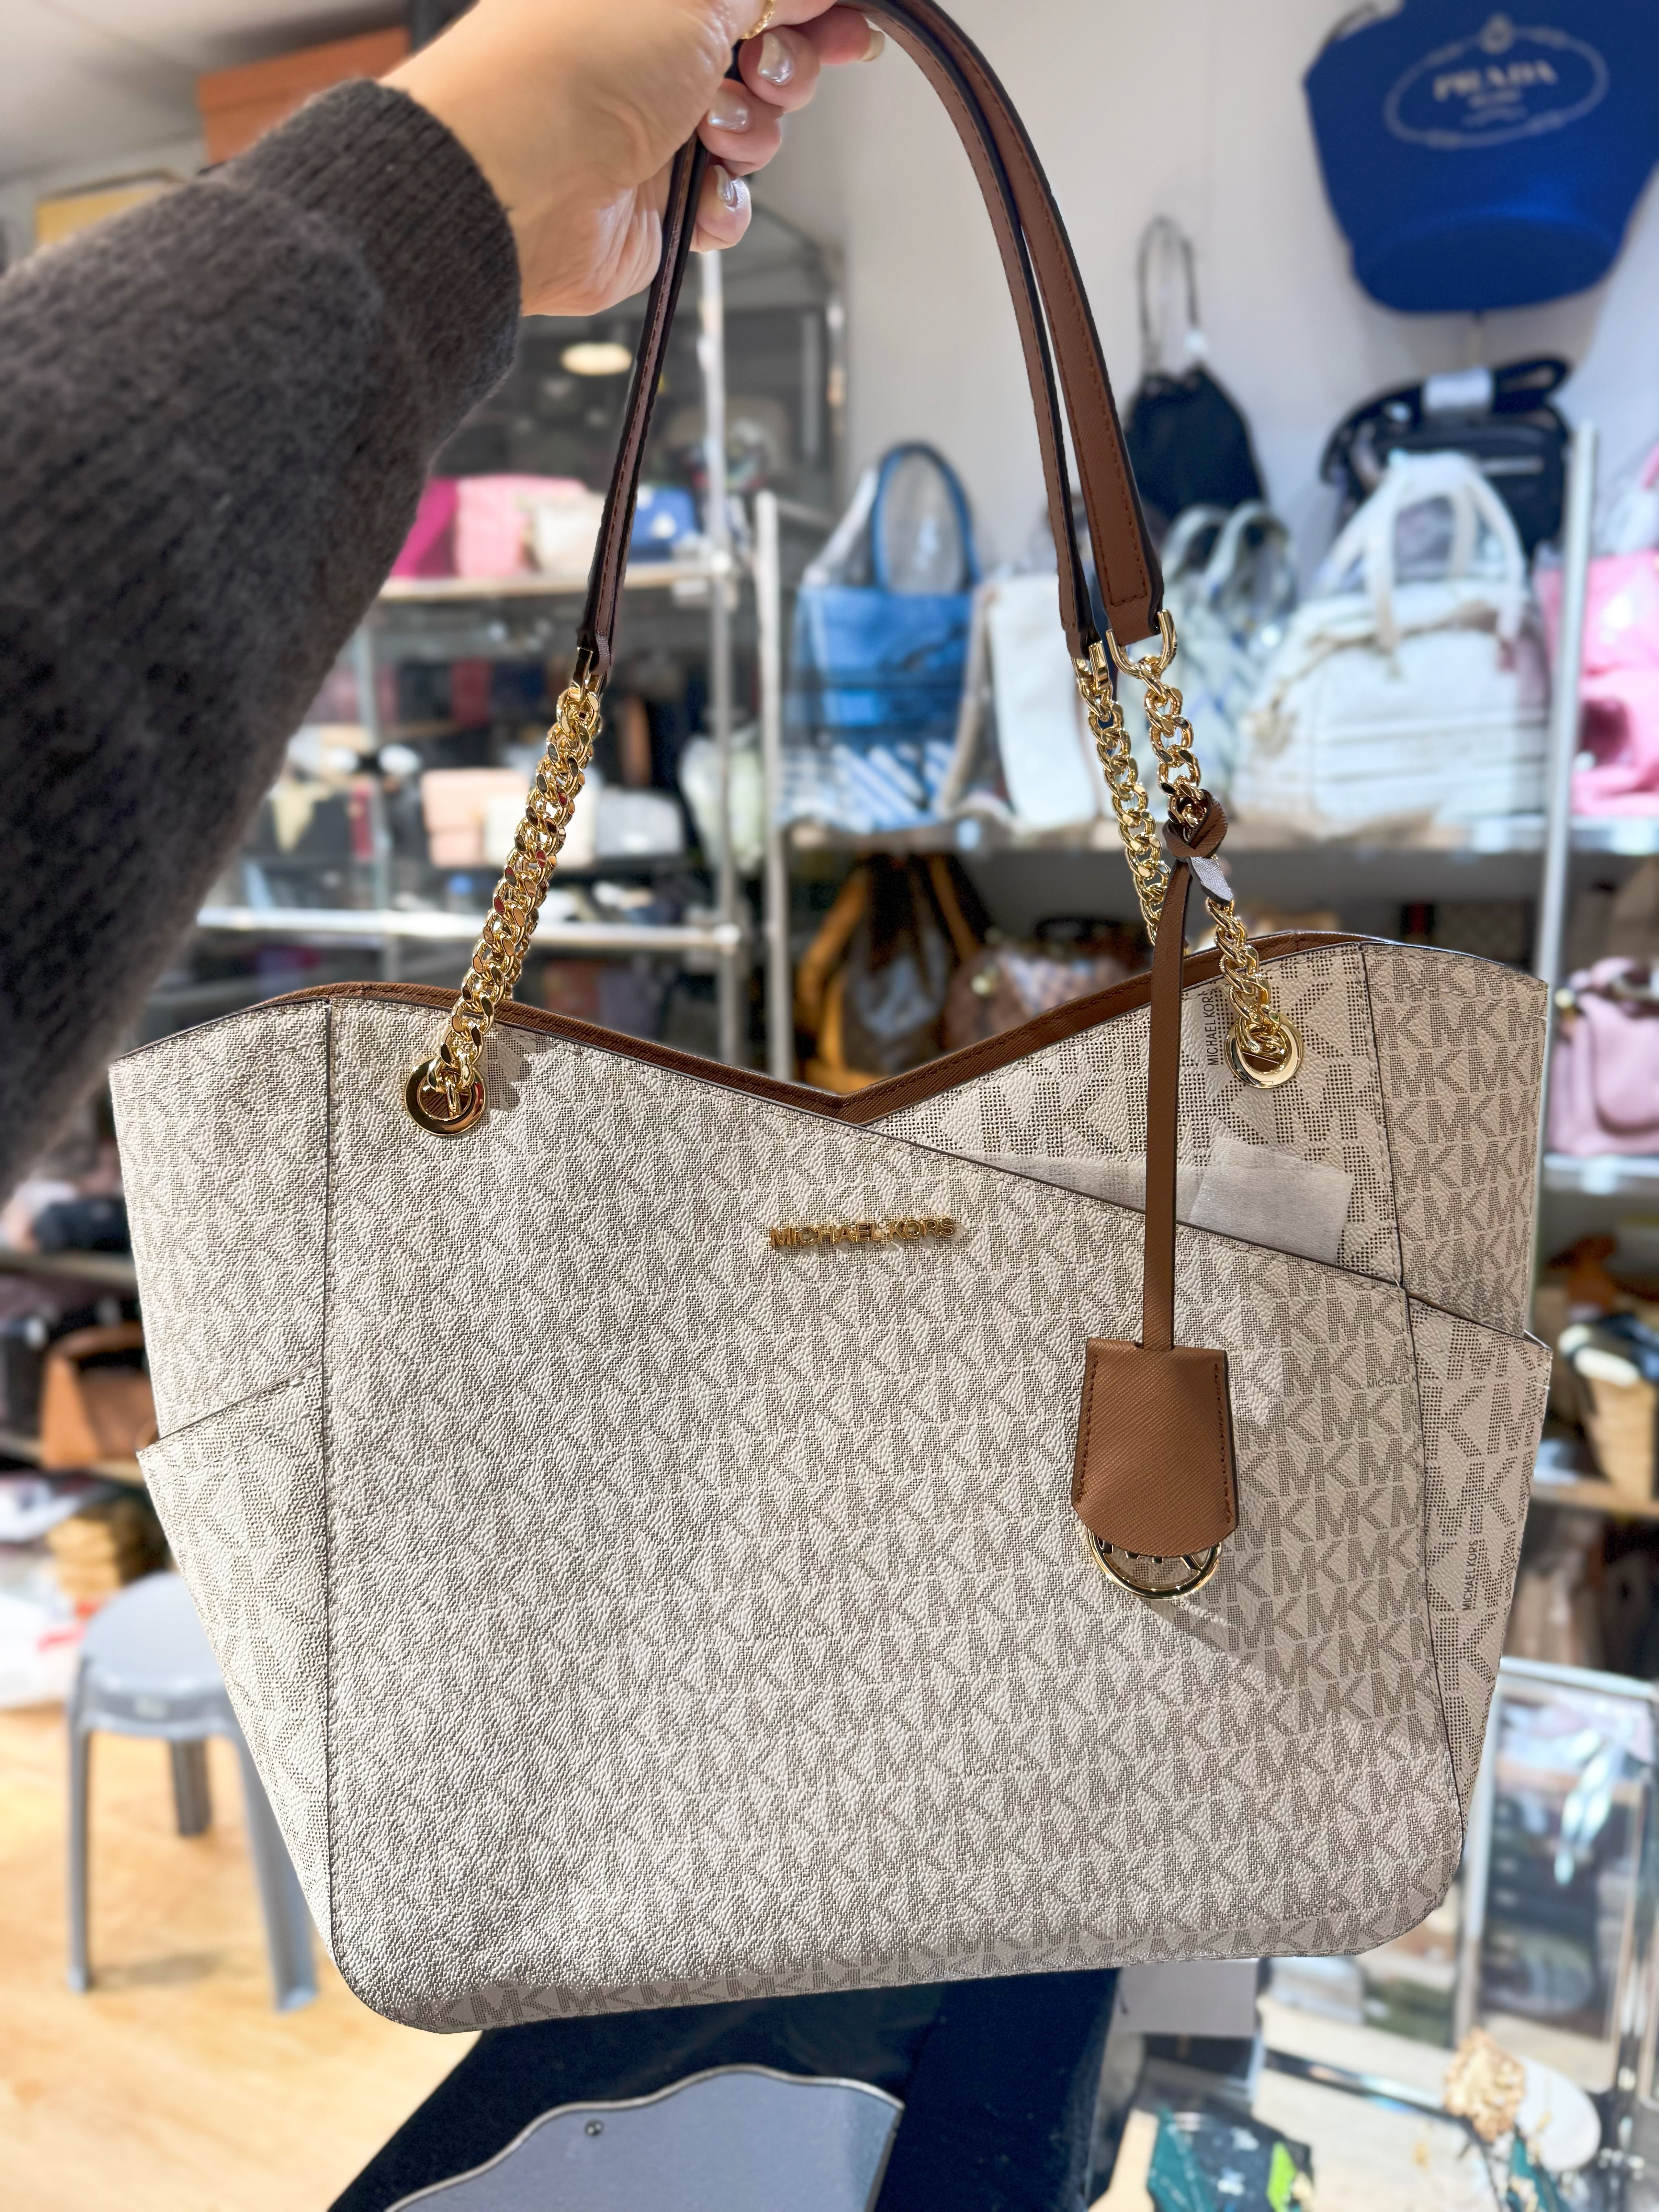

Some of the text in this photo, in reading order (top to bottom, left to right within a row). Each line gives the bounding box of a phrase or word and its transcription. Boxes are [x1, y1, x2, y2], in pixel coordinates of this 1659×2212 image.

[1434, 60, 1558, 101] PRADA
[1202, 990, 1219, 1065] MICHAEL KORS
[769, 1221, 883, 1247] MICHAEL
[890, 1217, 957, 1240] KORS
[1367, 1375, 1408, 1388] MICHAEL
[1462, 1539, 1479, 1611] MICHAEL KORS
[1283, 1904, 1357, 1921] MICHAEL KORS
